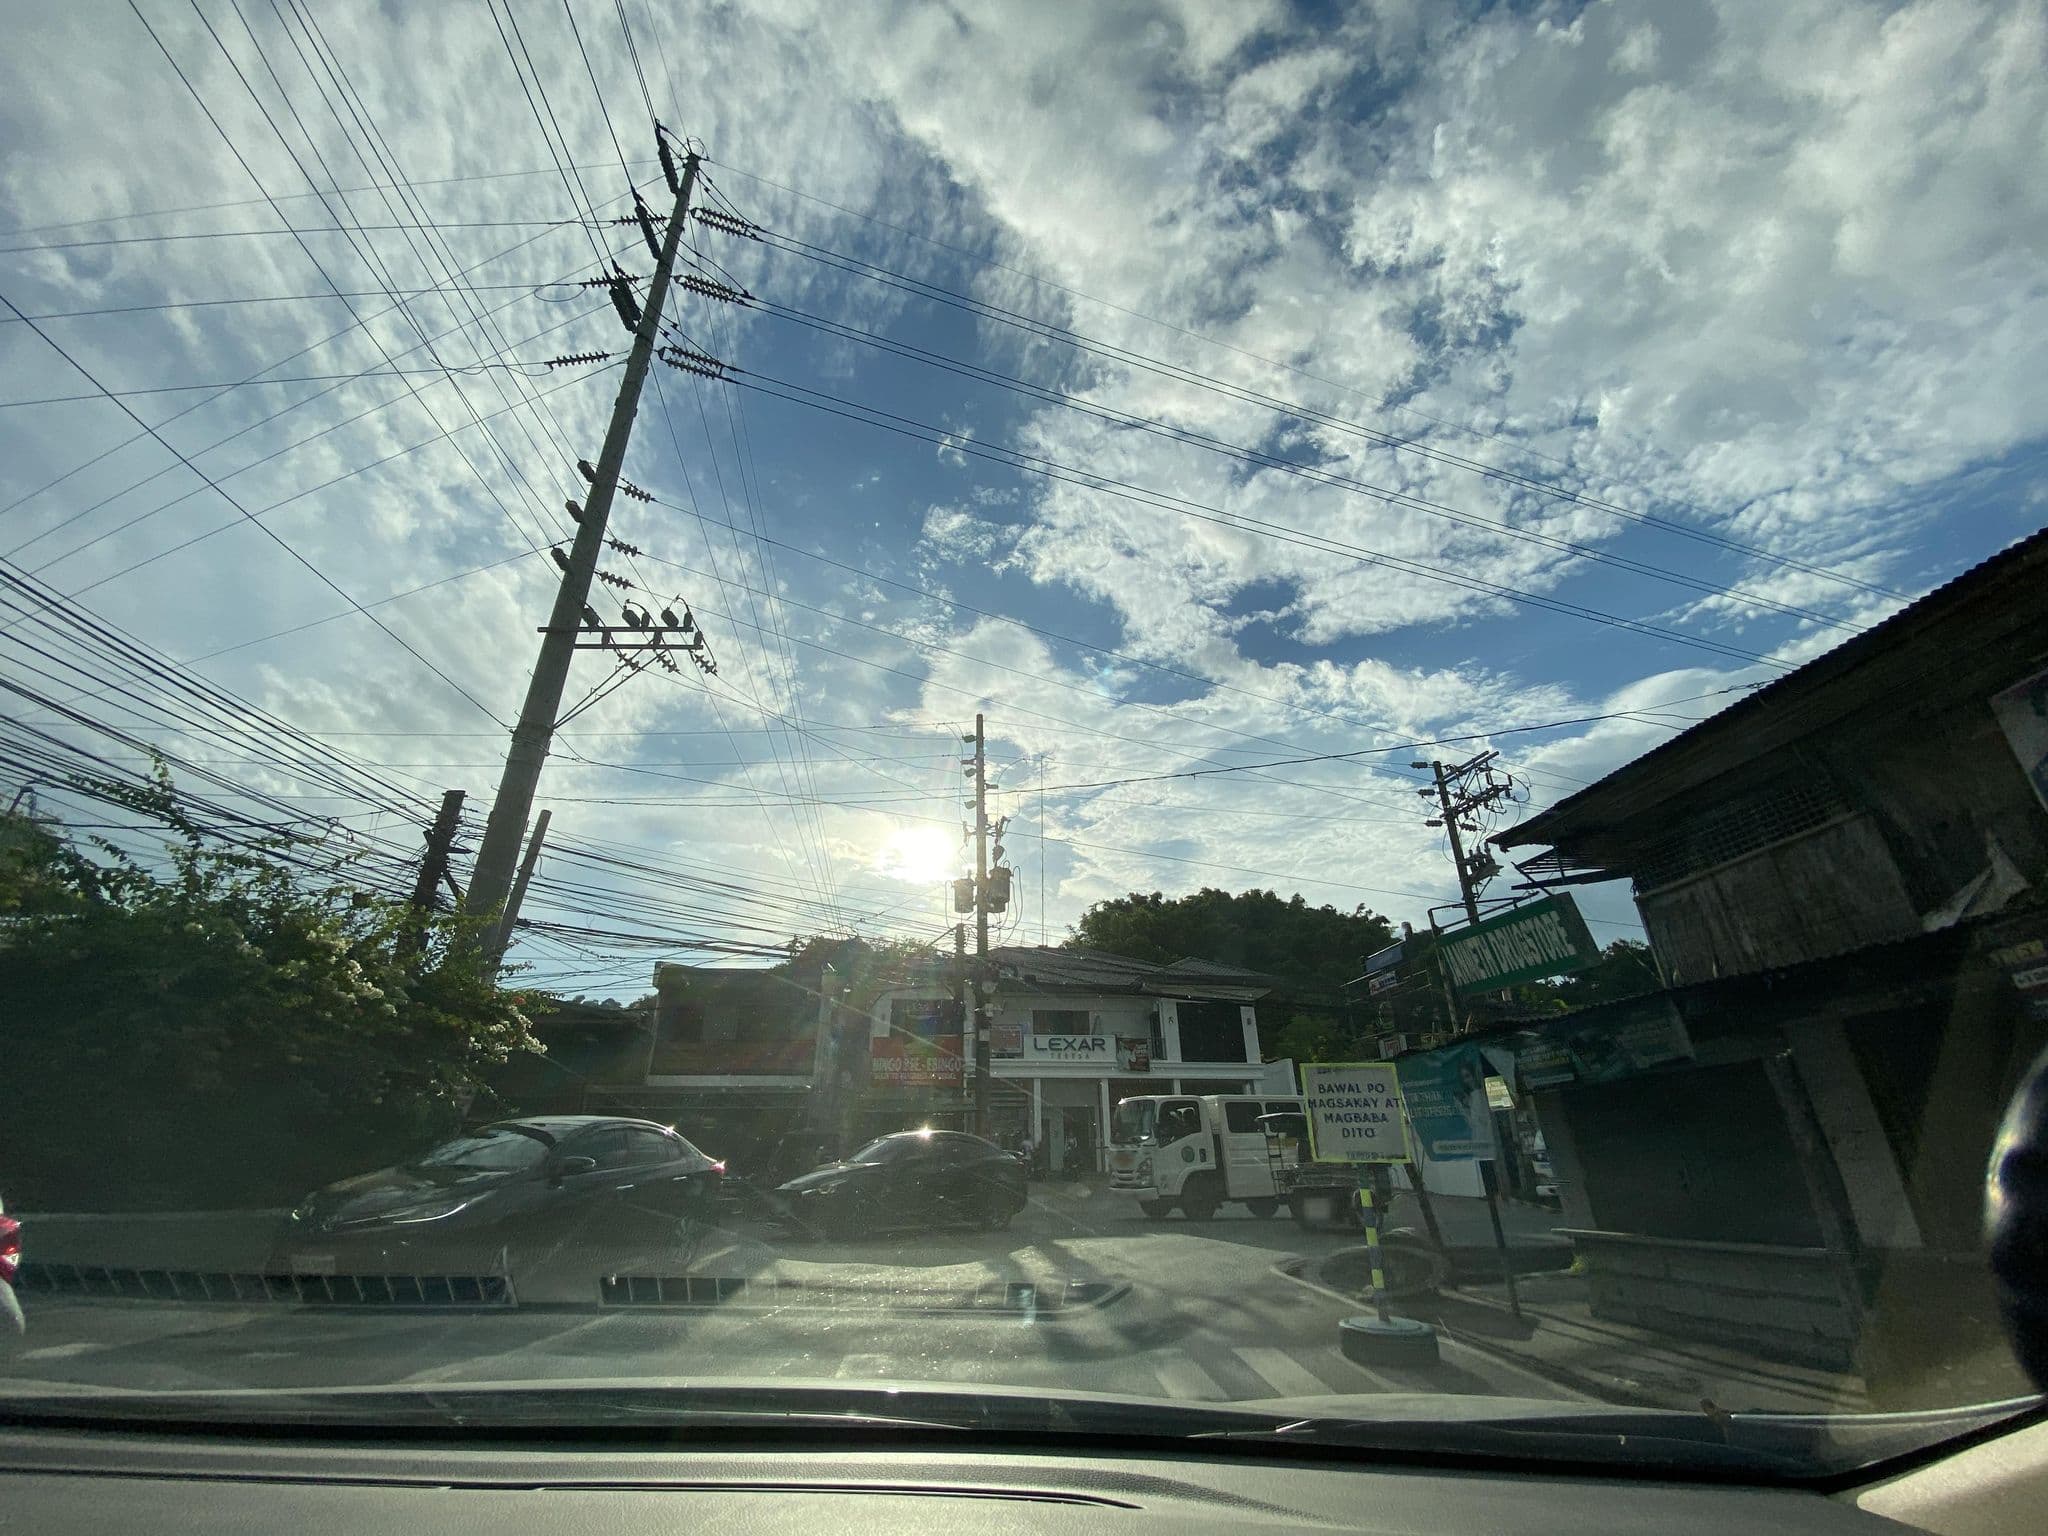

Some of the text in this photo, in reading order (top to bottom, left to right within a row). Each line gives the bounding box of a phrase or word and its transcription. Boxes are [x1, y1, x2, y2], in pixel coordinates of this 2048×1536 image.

[1486, 910, 1577, 974] DRUGSTORE
[1033, 1037, 1106, 1051] LEXAR
[1318, 1083, 1385, 1094] BAWAL PO
[1308, 1097, 1378, 1109] MAGSAKAY
[1385, 1098, 1401, 1108] AT
[1324, 1112, 1389, 1123] MAGBABA
[1341, 1127, 1377, 1138] DITO
